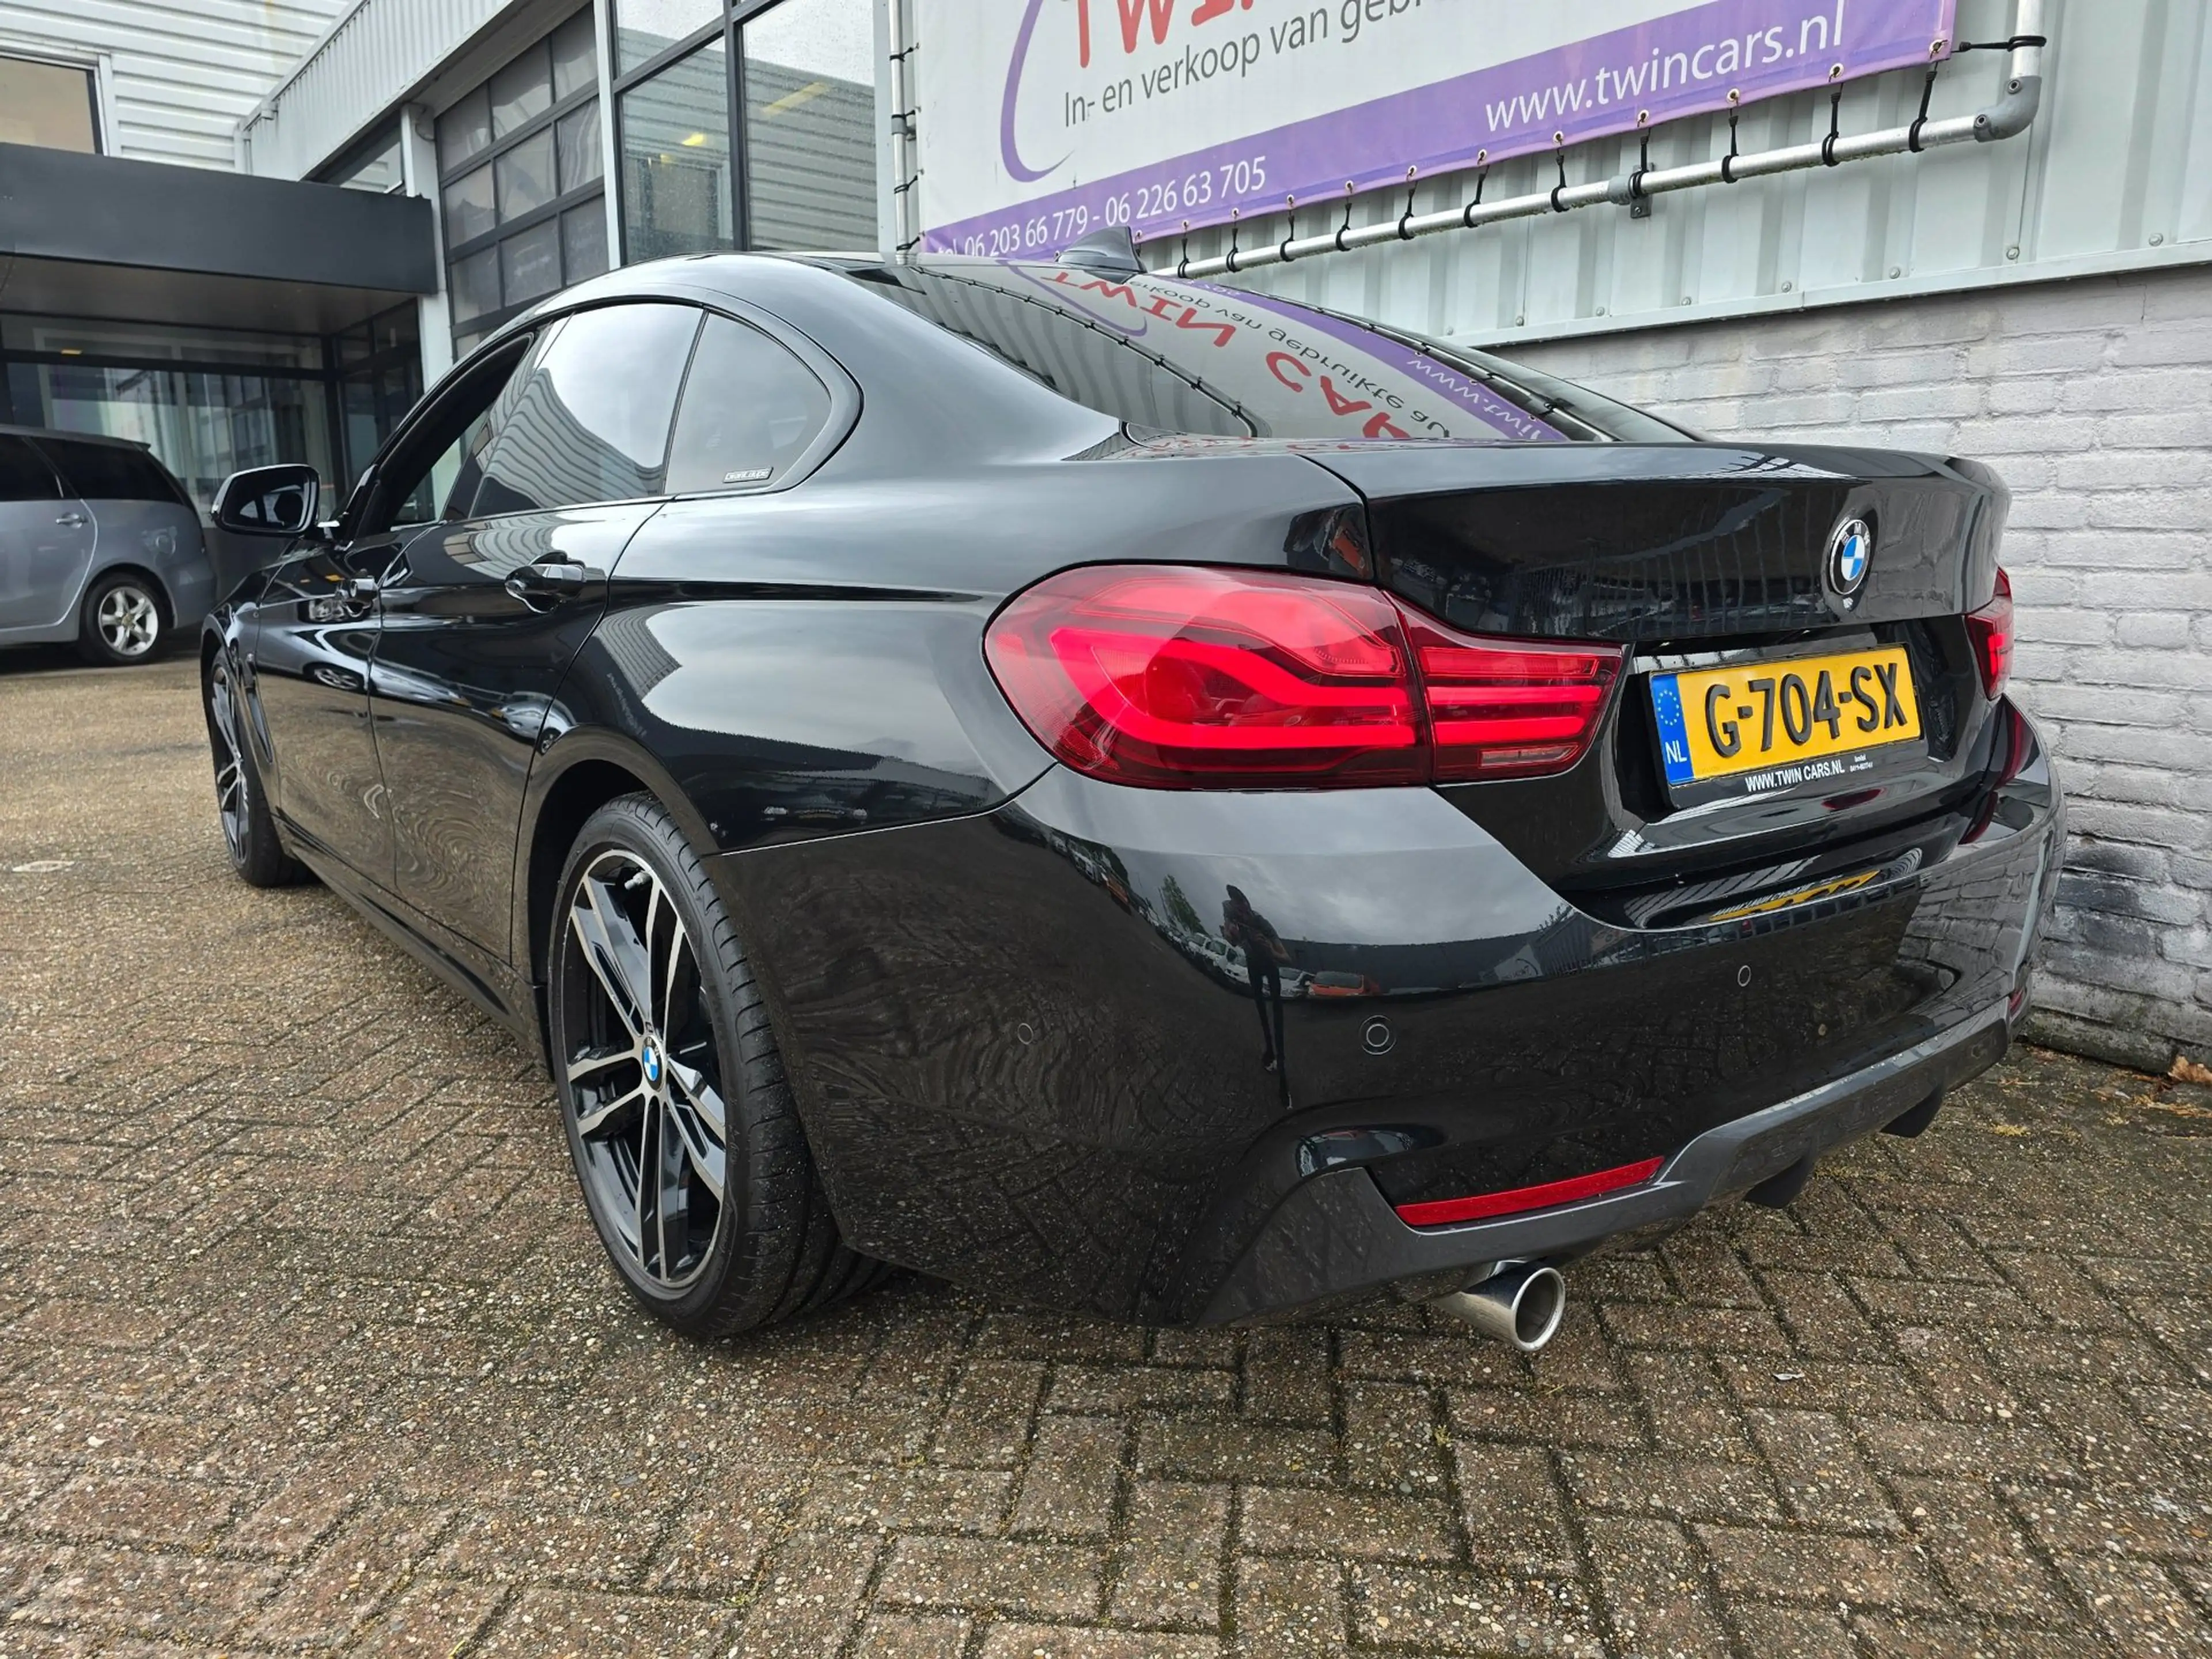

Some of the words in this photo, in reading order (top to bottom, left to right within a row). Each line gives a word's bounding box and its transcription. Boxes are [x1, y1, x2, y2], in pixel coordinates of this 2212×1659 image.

[1065, 92, 1096, 127] In-
[1103, 77, 1132, 113] en
[1141, 32, 1260, 99] verkoop
[1270, 8, 1327, 55] van
[1340, 0, 1421, 43] geb
[1485, 0, 1843, 132] www.twincars.nl
[990, 224, 1021, 257] 203
[1025, 216, 1047, 248] 66
[1053, 205, 1088, 240] 779
[1105, 192, 1131, 226] 06
[1137, 180, 1176, 220] 226
[1183, 171, 1211, 205] 63
[1219, 155, 1266, 199] 705
[1665, 740, 1687, 764] NL
[1705, 662, 1908, 759] G-704-SX
[1745, 767, 1802, 792] WWW.TWIN
[1804, 760, 1846, 781] CARS.NL
